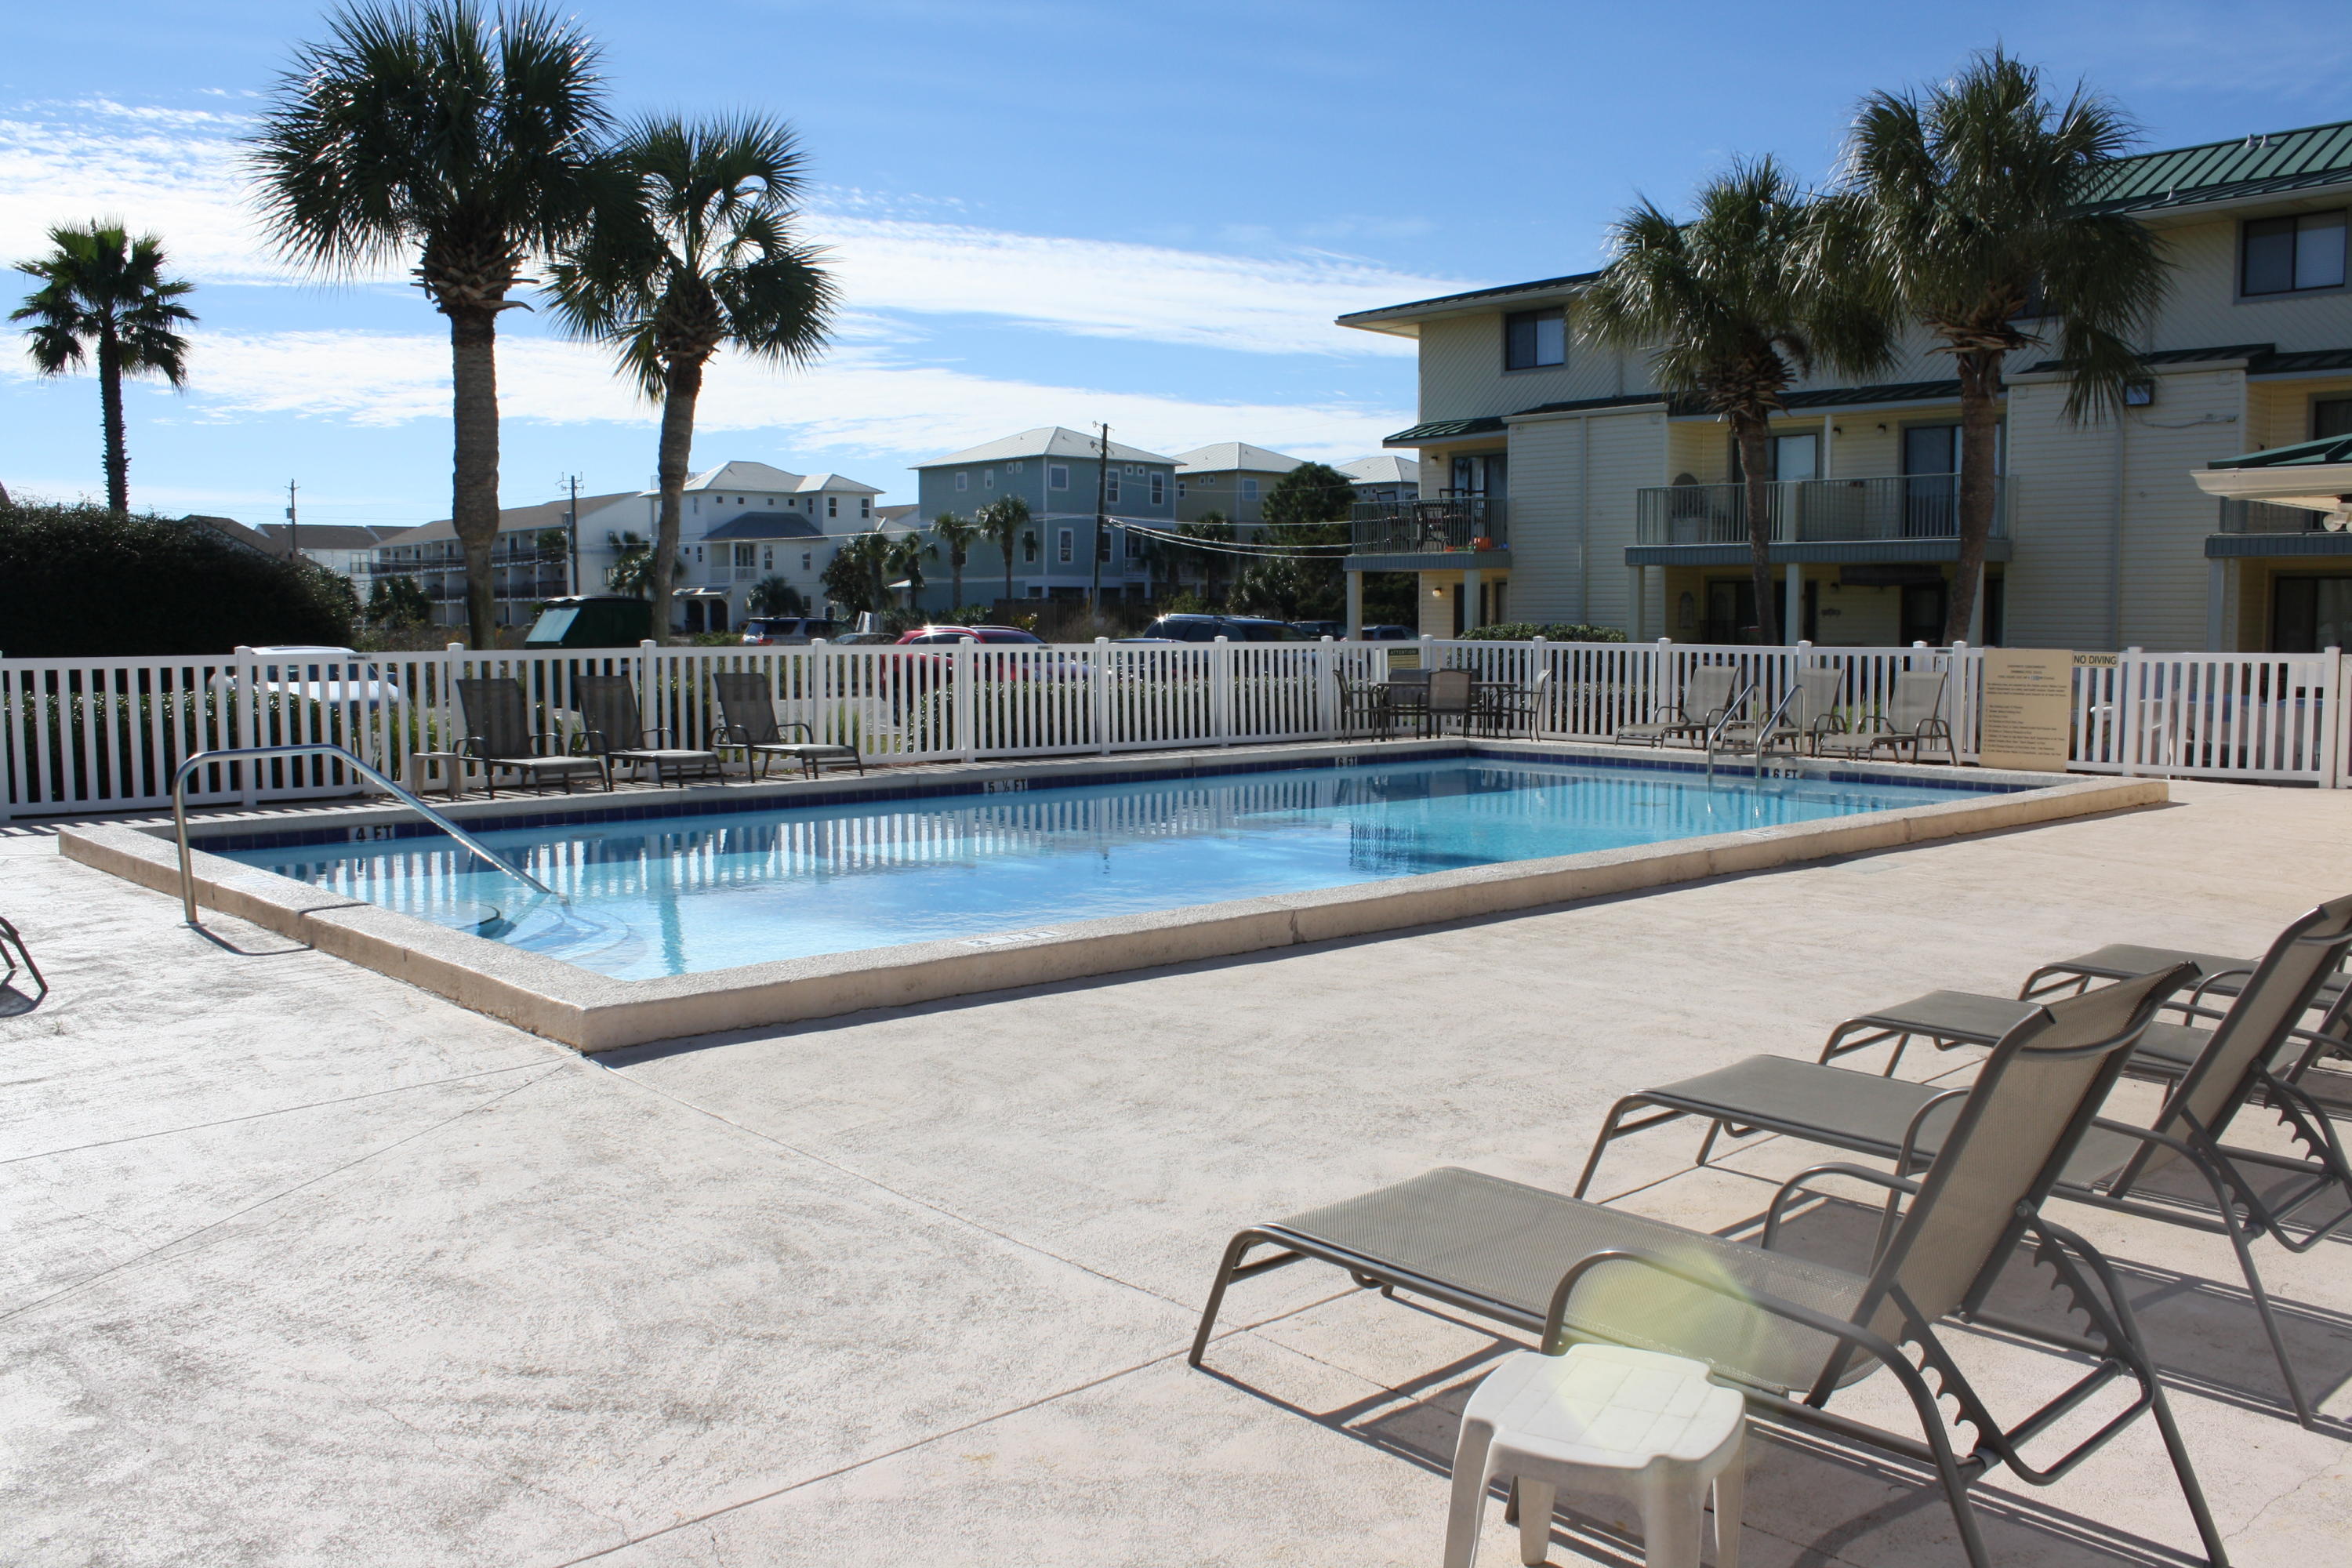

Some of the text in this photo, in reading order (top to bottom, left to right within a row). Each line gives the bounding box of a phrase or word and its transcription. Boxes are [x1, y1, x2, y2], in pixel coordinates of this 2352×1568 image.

[2074, 655, 2117, 665] NO DIVING
[1347, 757, 1356, 766] FT
[1773, 768, 1798, 779] 6 FT
[1014, 779, 1026, 791] FT
[356, 825, 392, 840] 4 FT
